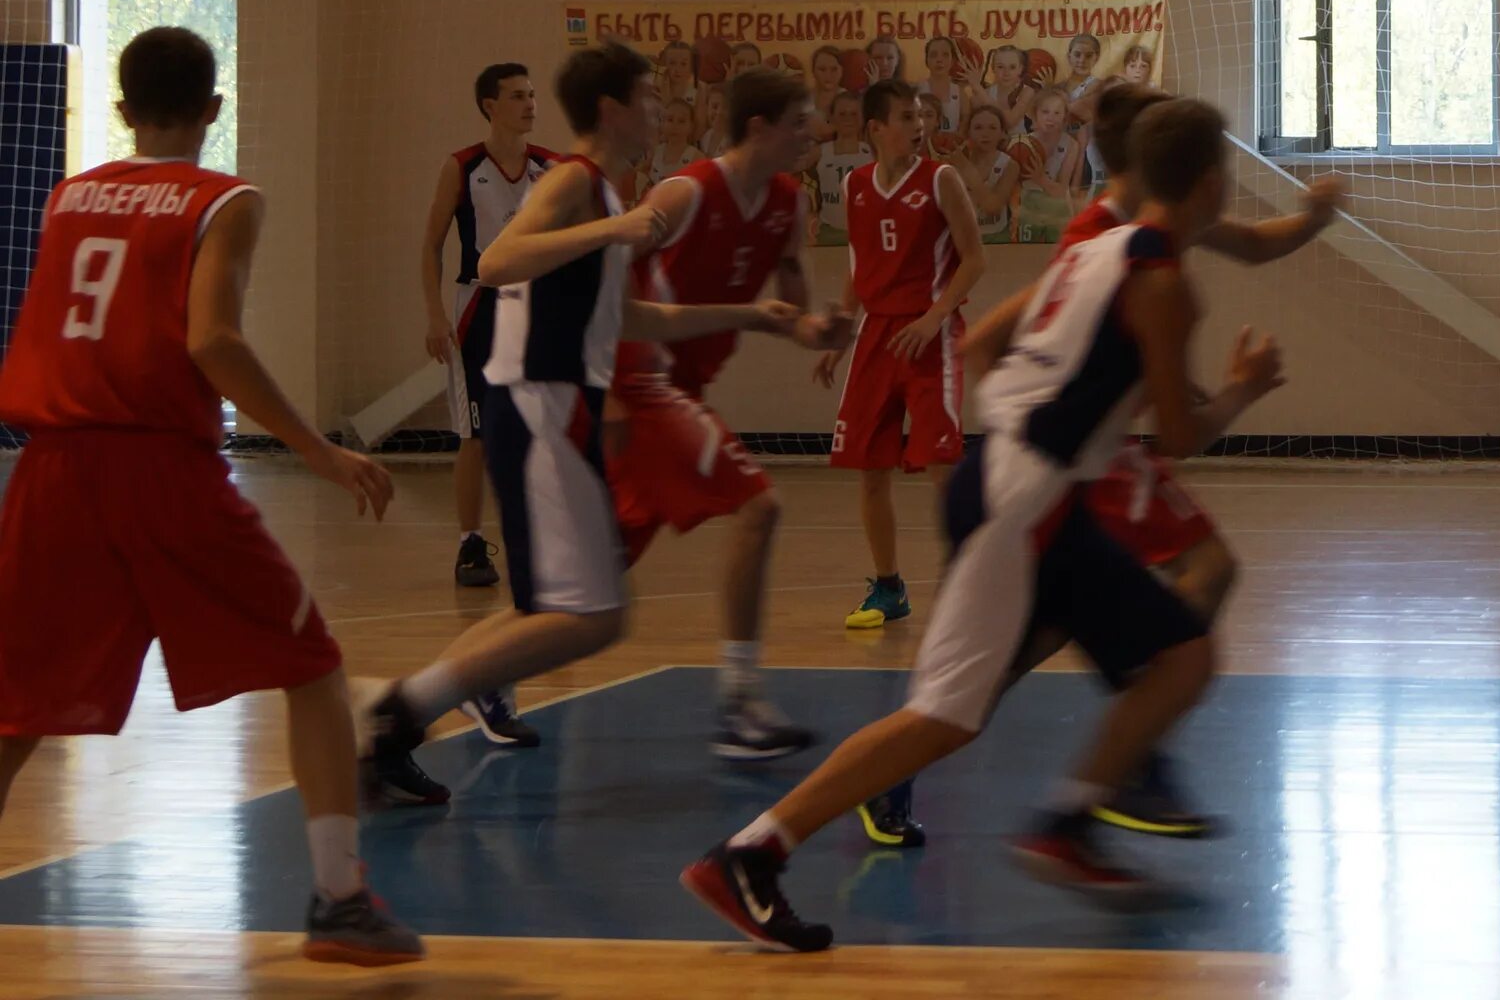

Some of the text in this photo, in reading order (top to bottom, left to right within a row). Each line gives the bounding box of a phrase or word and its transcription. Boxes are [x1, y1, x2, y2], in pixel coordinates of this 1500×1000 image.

[595, 3, 1164, 42] БЫТЬ ПЕРВЫМИ! БЫТЬ ЛУЧШИМИ!
[53, 180, 198, 217] ЛЮБЕРЦЫ
[880, 218, 897, 252] 6
[62, 237, 129, 341] 9
[832, 420, 847, 452] 6
